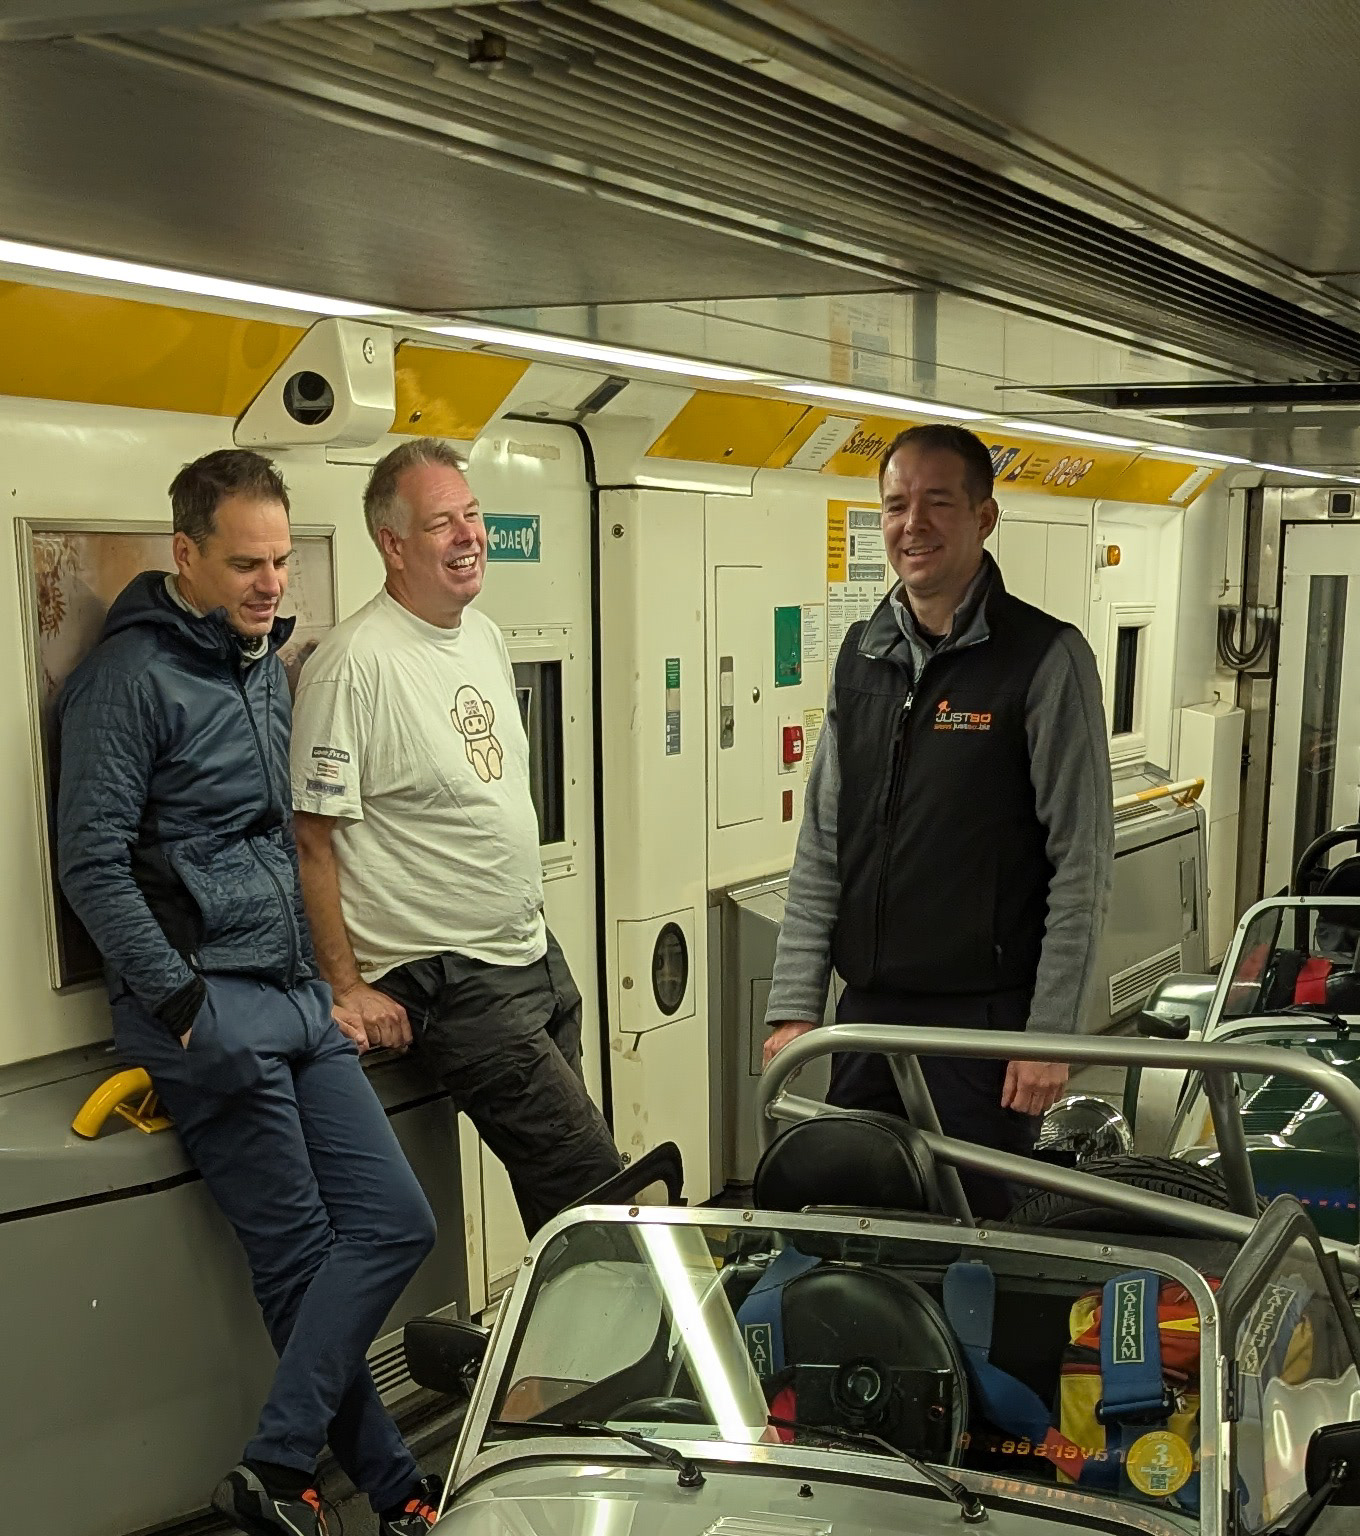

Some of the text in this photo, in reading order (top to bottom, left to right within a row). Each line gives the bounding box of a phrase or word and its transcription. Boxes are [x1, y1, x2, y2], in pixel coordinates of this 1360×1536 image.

[842, 430, 886, 461] Safety
[500, 529, 521, 549] DAE
[1121, 1282, 1138, 1360] CATERHAM
[1243, 1286, 1287, 1373] CATERHAM
[751, 1329, 767, 1380] CAT
[1152, 1443, 1169, 1465] 3
